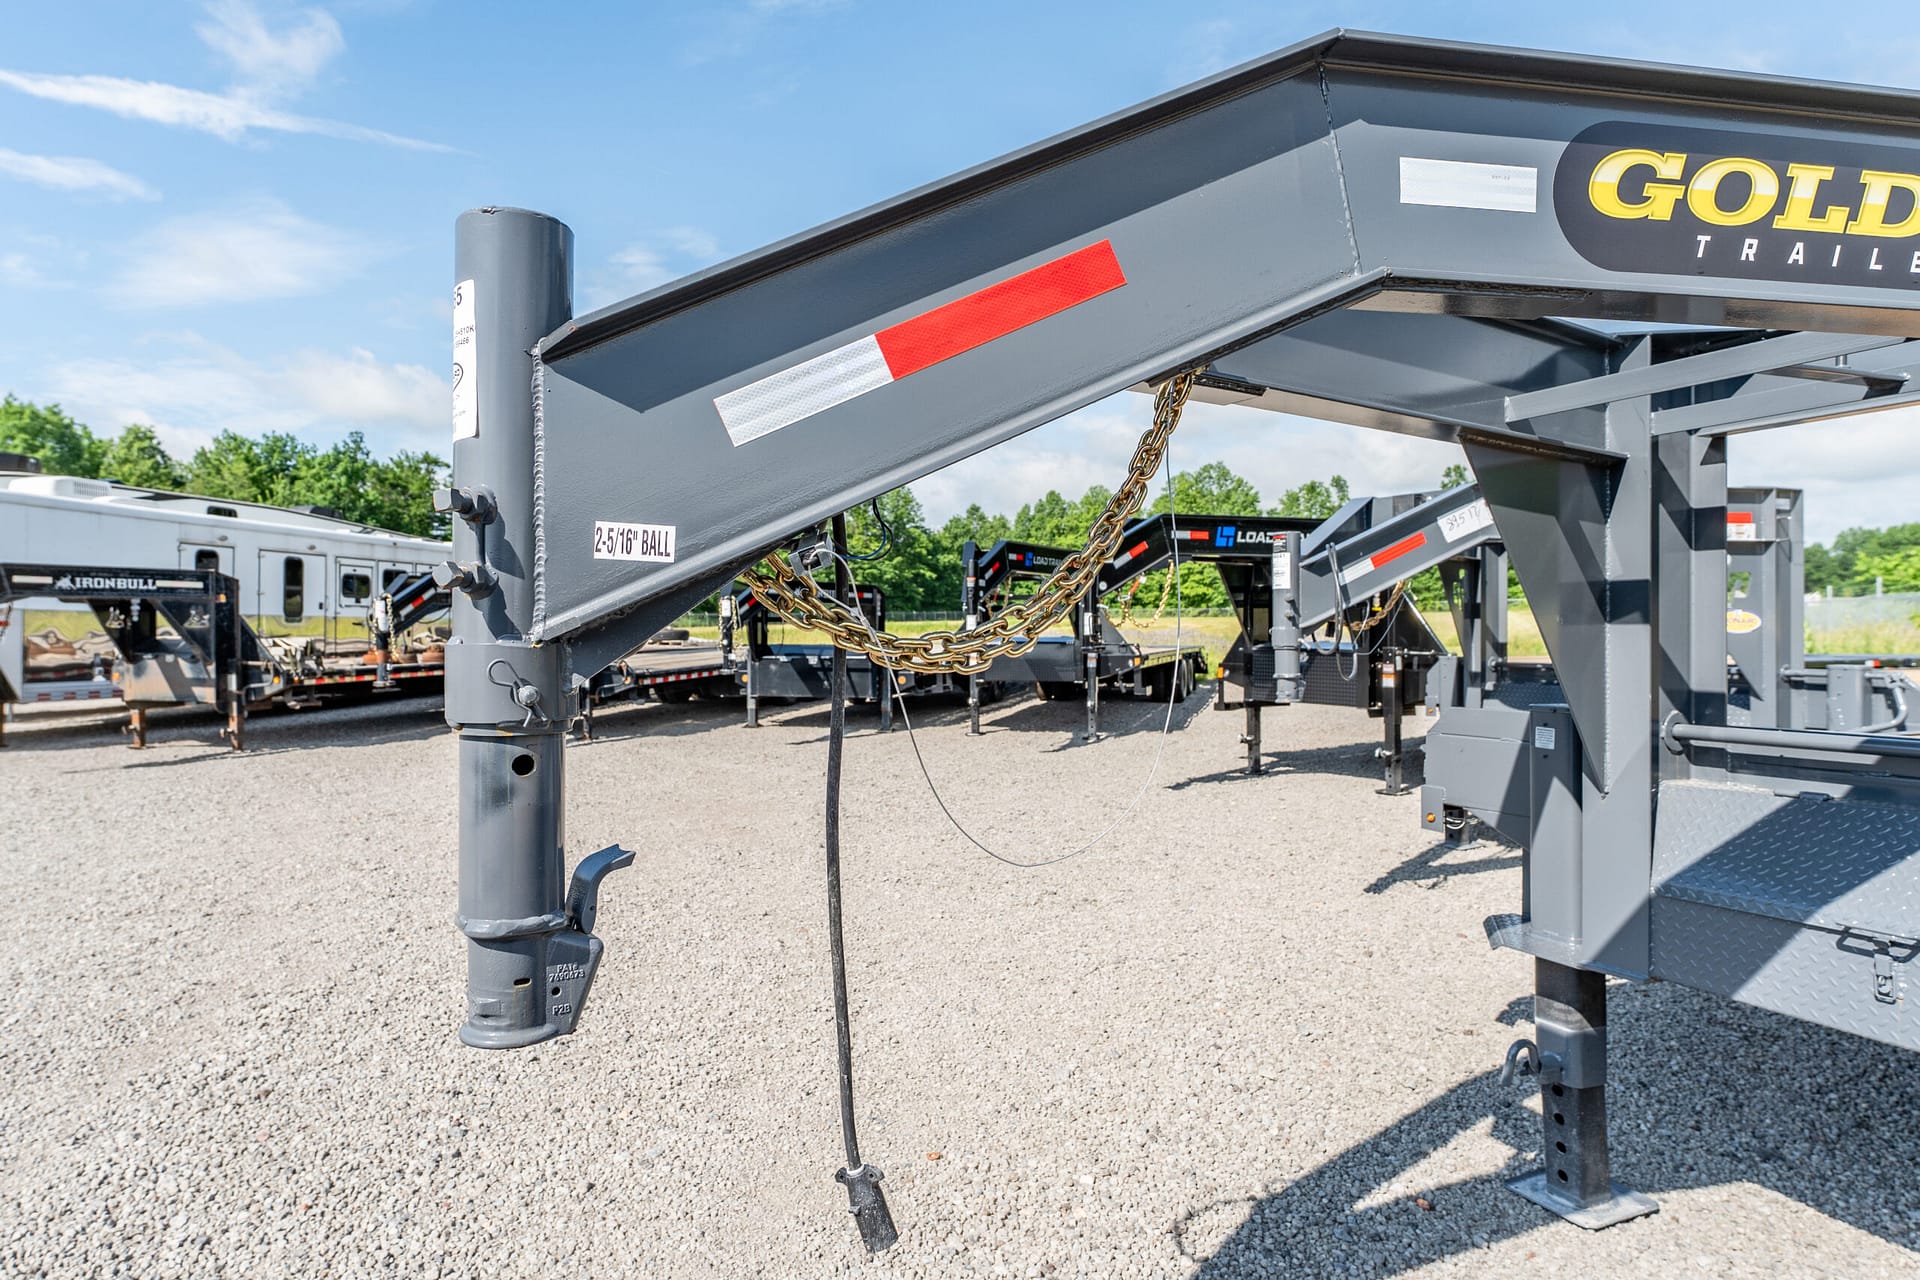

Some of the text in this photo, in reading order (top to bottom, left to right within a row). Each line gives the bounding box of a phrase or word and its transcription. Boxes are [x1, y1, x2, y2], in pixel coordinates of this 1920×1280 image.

[1588, 148, 1920, 238] GOLD
[594, 526, 671, 557] 2-5/16" BALL
[74, 576, 157, 591] IRONBULL
